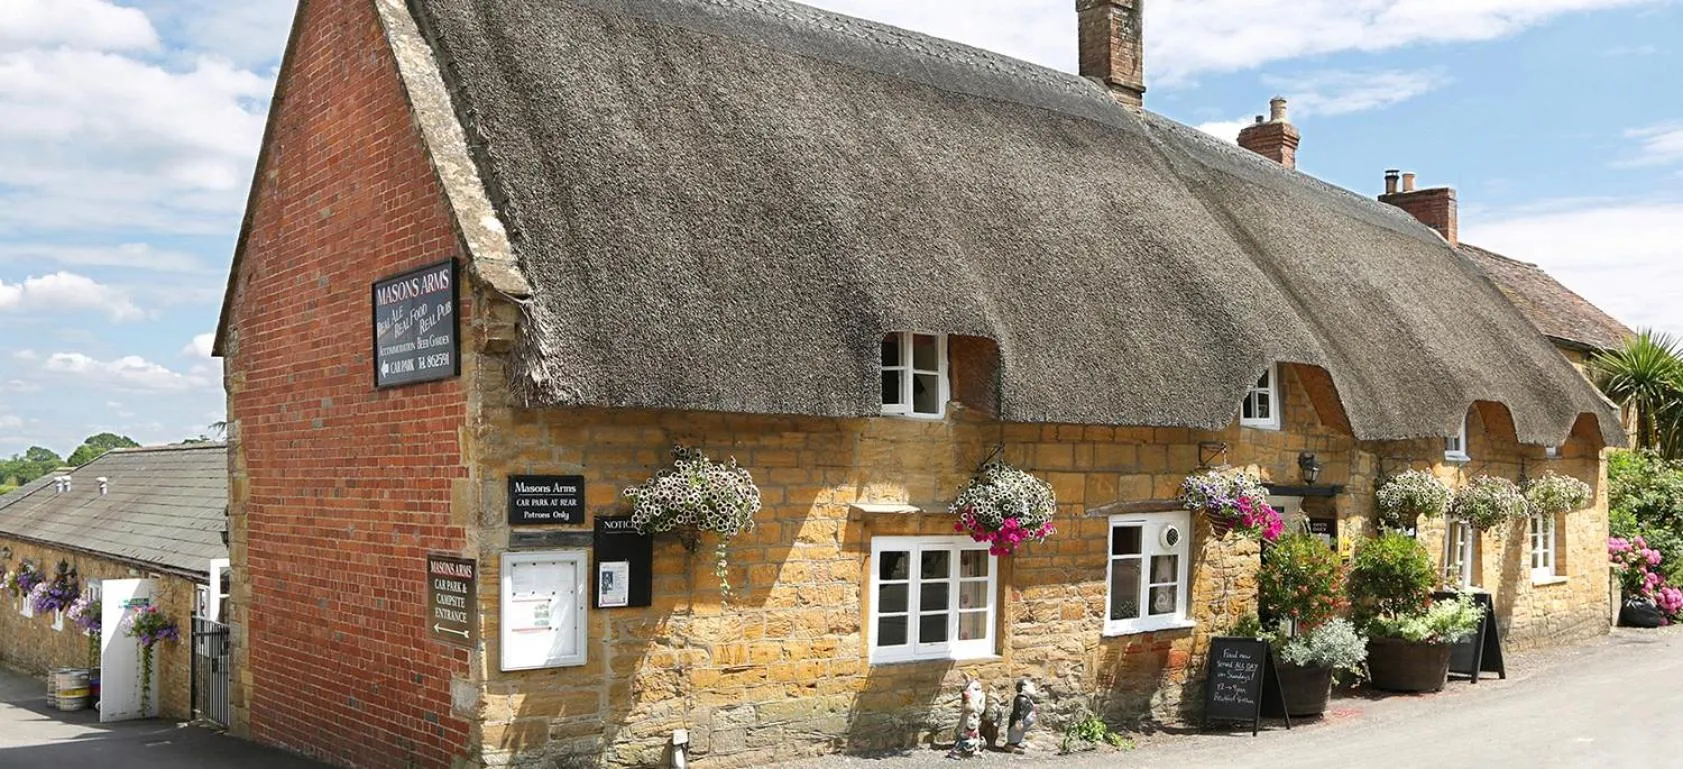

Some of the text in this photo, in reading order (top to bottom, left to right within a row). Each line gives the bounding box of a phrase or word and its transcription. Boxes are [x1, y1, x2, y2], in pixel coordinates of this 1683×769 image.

[377, 269, 449, 305] MASONS ARMS
[391, 361, 401, 374] CAR
[401, 358, 415, 373] PARK
[515, 481, 577, 493] Masons Arms
[516, 498, 577, 507] CAR PARK AT REAR
[523, 511, 570, 521] Patrons Only
[604, 520, 638, 529] NOTIC
[430, 560, 472, 578] MASONS ARMS
[435, 578, 467, 594] CAR PARK &
[436, 593, 465, 608] CAMPSITE
[435, 606, 467, 623] ENTRANCE
